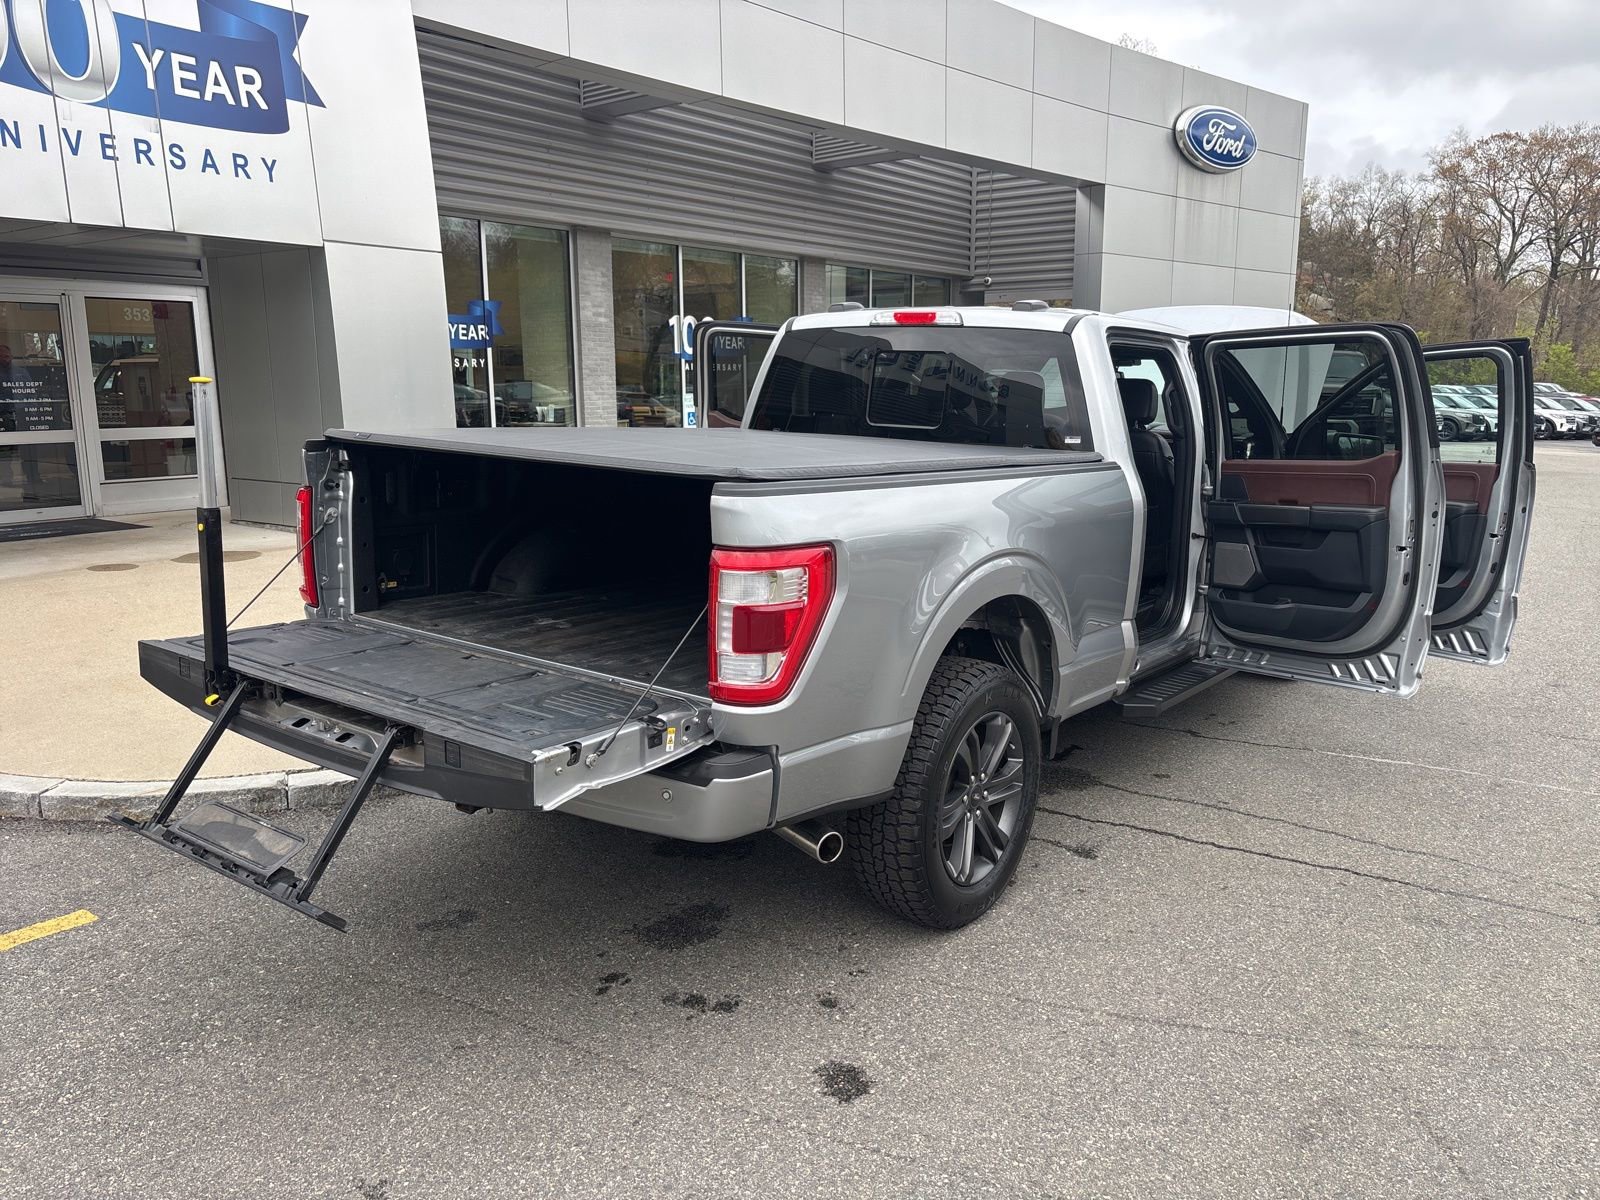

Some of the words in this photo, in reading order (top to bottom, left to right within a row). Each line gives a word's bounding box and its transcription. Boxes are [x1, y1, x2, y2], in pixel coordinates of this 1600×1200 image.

[131, 42, 269, 110] YEAR
[1202, 118, 1246, 159] Ford
[123, 307, 151, 322] 353
[448, 322, 490, 341] YEAR
[719, 335, 746, 350] YEAR
